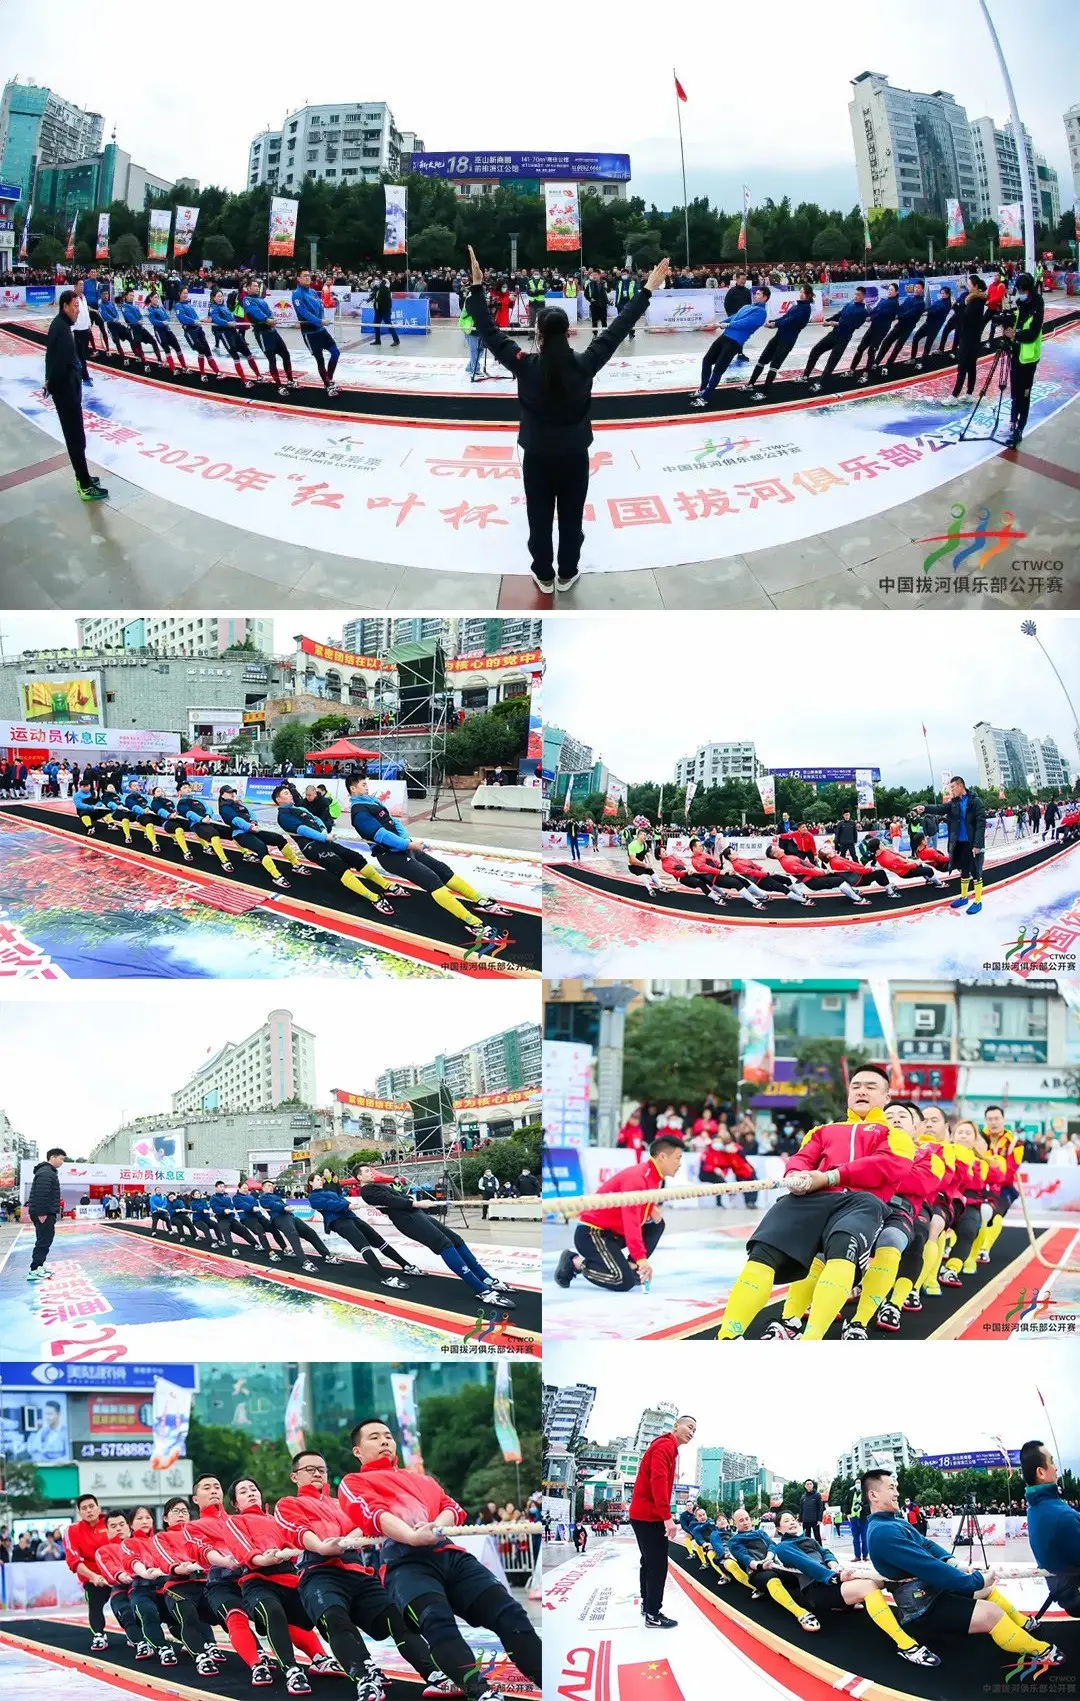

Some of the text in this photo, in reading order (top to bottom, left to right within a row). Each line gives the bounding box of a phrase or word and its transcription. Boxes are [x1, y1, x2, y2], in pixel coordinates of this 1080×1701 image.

[446, 155, 470, 174] 18
[10, 726, 108, 746] 运动员休息区
[119, 1168, 186, 1181] 运动员休息区
